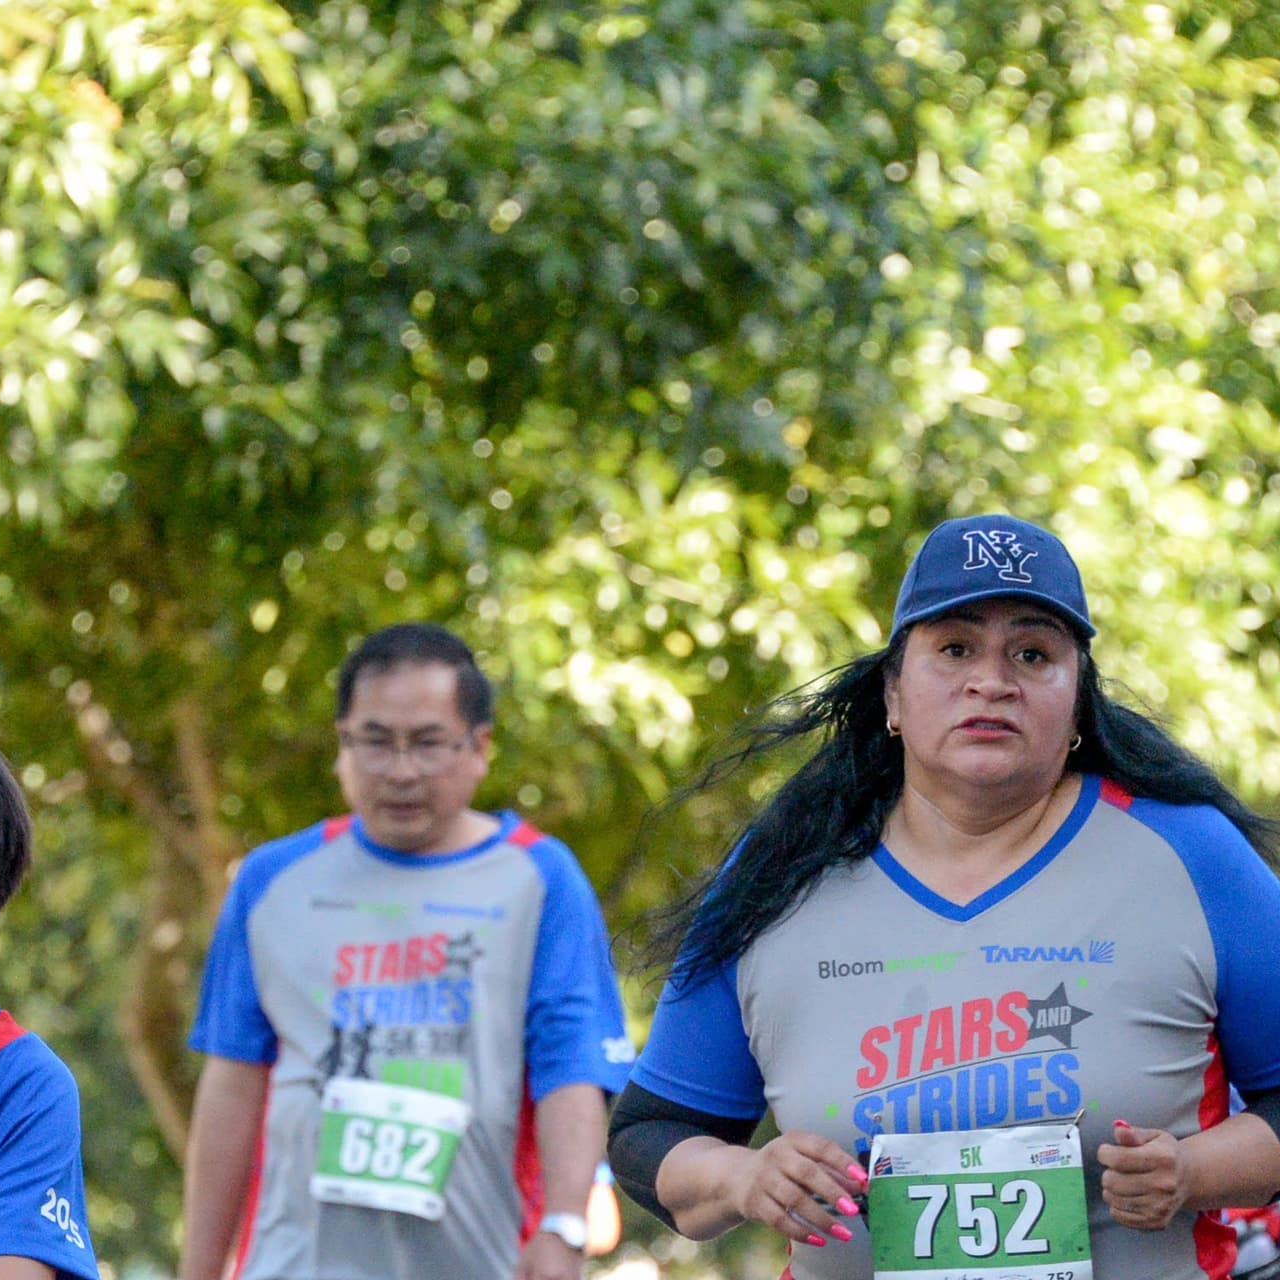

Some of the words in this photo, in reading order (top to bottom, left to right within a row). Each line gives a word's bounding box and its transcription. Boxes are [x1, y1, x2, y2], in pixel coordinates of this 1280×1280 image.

[963, 530, 1038, 583] NY
[980, 945, 1083, 964] TARANA
[856, 990, 1030, 1089] STARS
[1035, 1006, 1072, 1030] AND
[853, 1053, 1081, 1153] STRIDES
[340, 1117, 441, 1185] 682
[960, 1145, 982, 1169] 5K
[40, 1189, 85, 1249] 205
[907, 1179, 1051, 1258] 752
